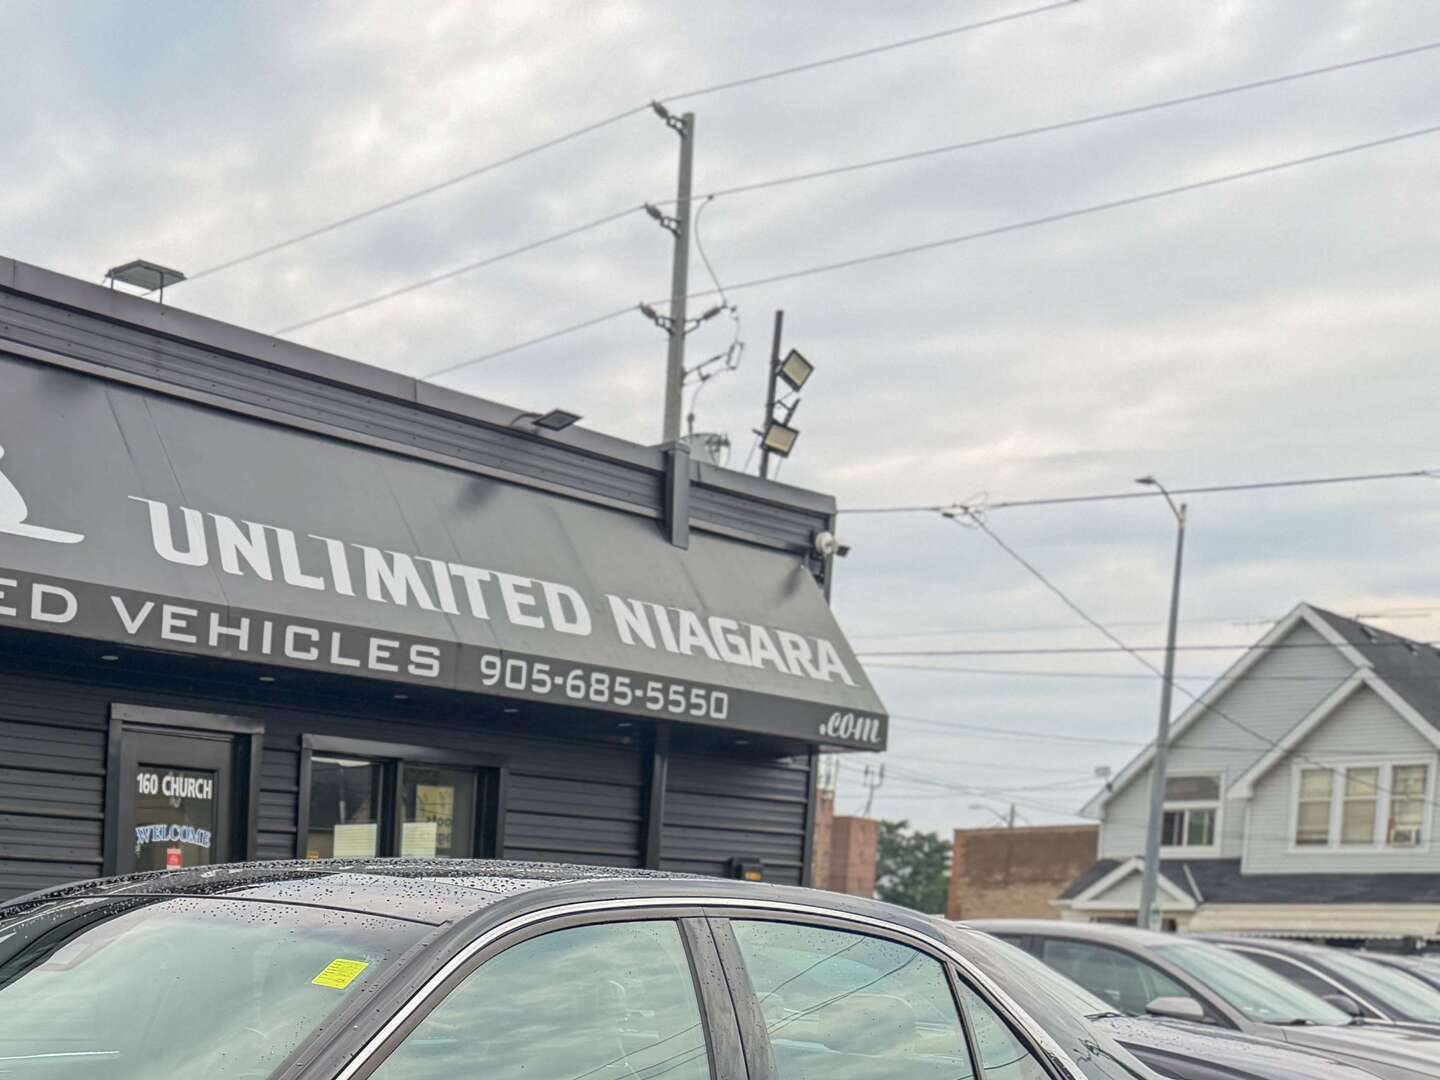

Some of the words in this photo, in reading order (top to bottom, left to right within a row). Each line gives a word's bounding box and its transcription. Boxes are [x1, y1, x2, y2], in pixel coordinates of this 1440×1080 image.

[127, 495, 593, 637] UNLIMITED
[604, 594, 860, 688] NIAGARA
[110, 595, 441, 678] VEHICLES
[480, 654, 729, 720] 905-685-5550
[819, 711, 881, 744] .com
[136, 773, 159, 795] 160
[162, 775, 213, 800] CHURCH
[135, 824, 212, 848] WELCOME
